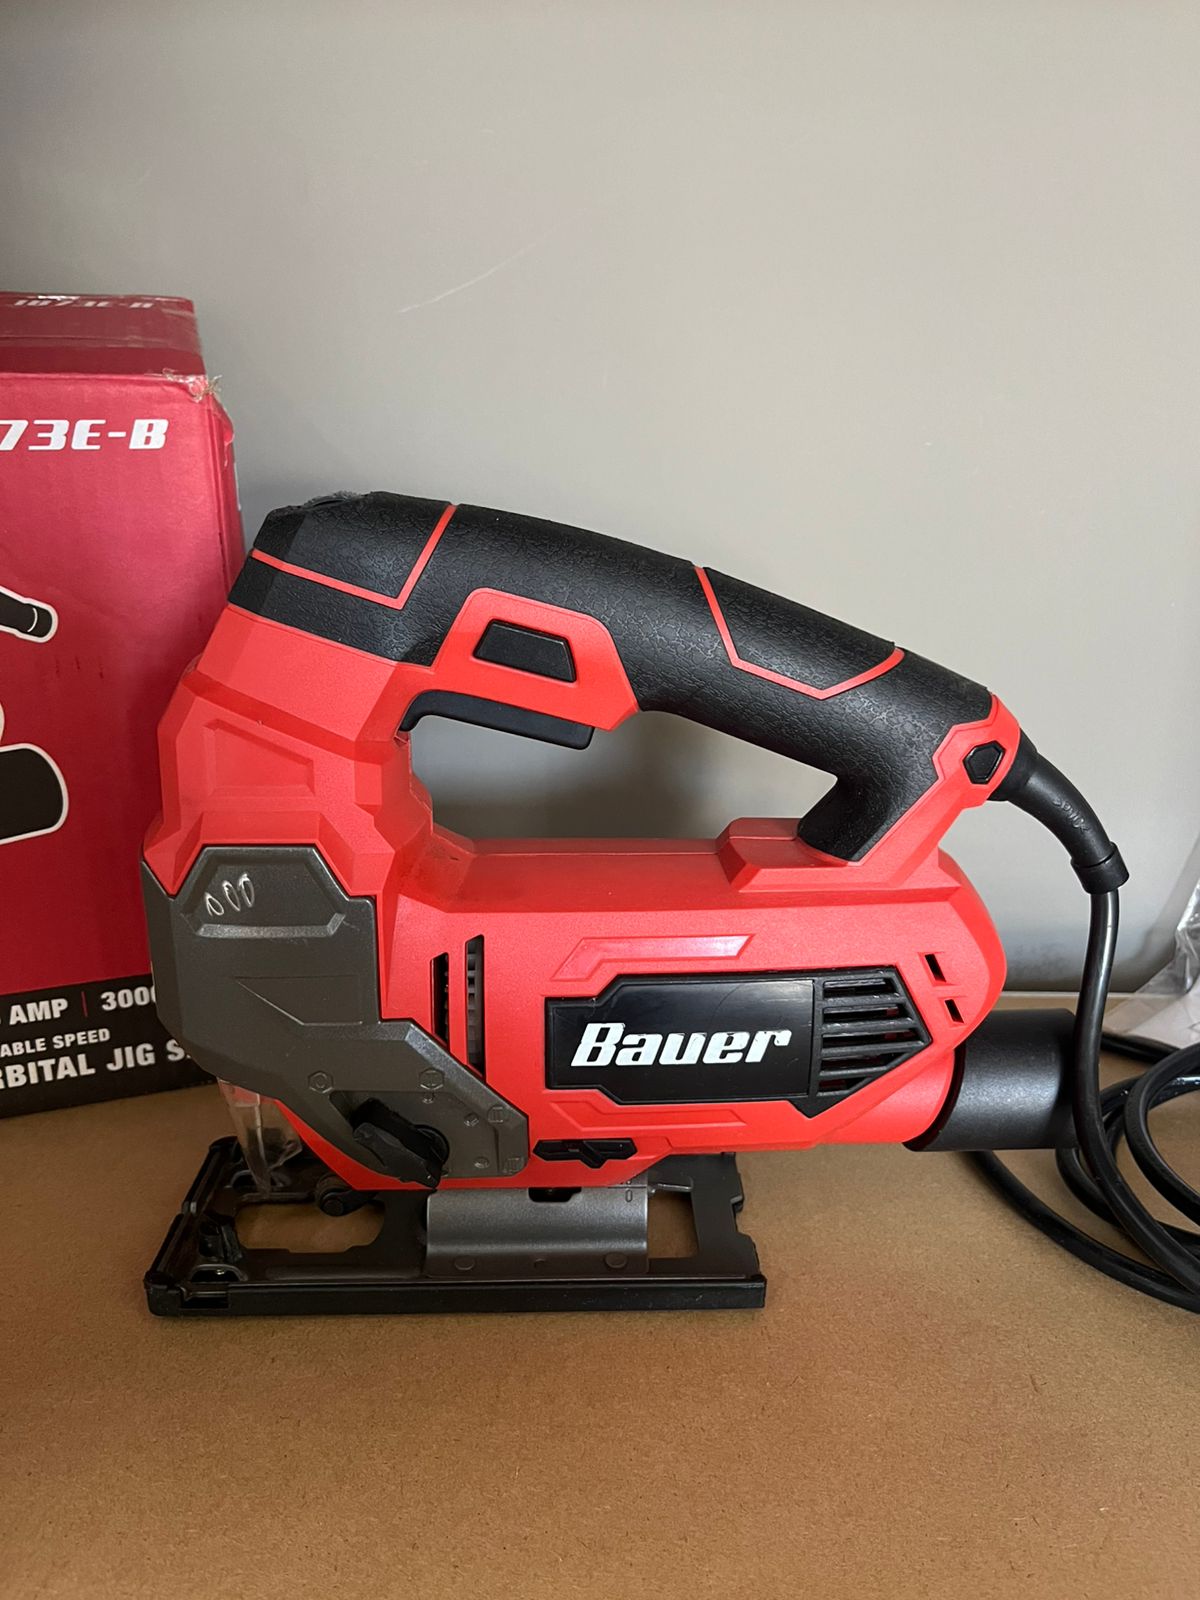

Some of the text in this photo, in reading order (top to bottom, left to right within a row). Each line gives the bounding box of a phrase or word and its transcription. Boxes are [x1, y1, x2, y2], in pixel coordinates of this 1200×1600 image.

[9, 998, 68, 1025] AMP
[53, 1028, 111, 1049] SPEED
[570, 1022, 793, 1067] Bauer
[0, 1038, 191, 1089] BITAL JIG S
